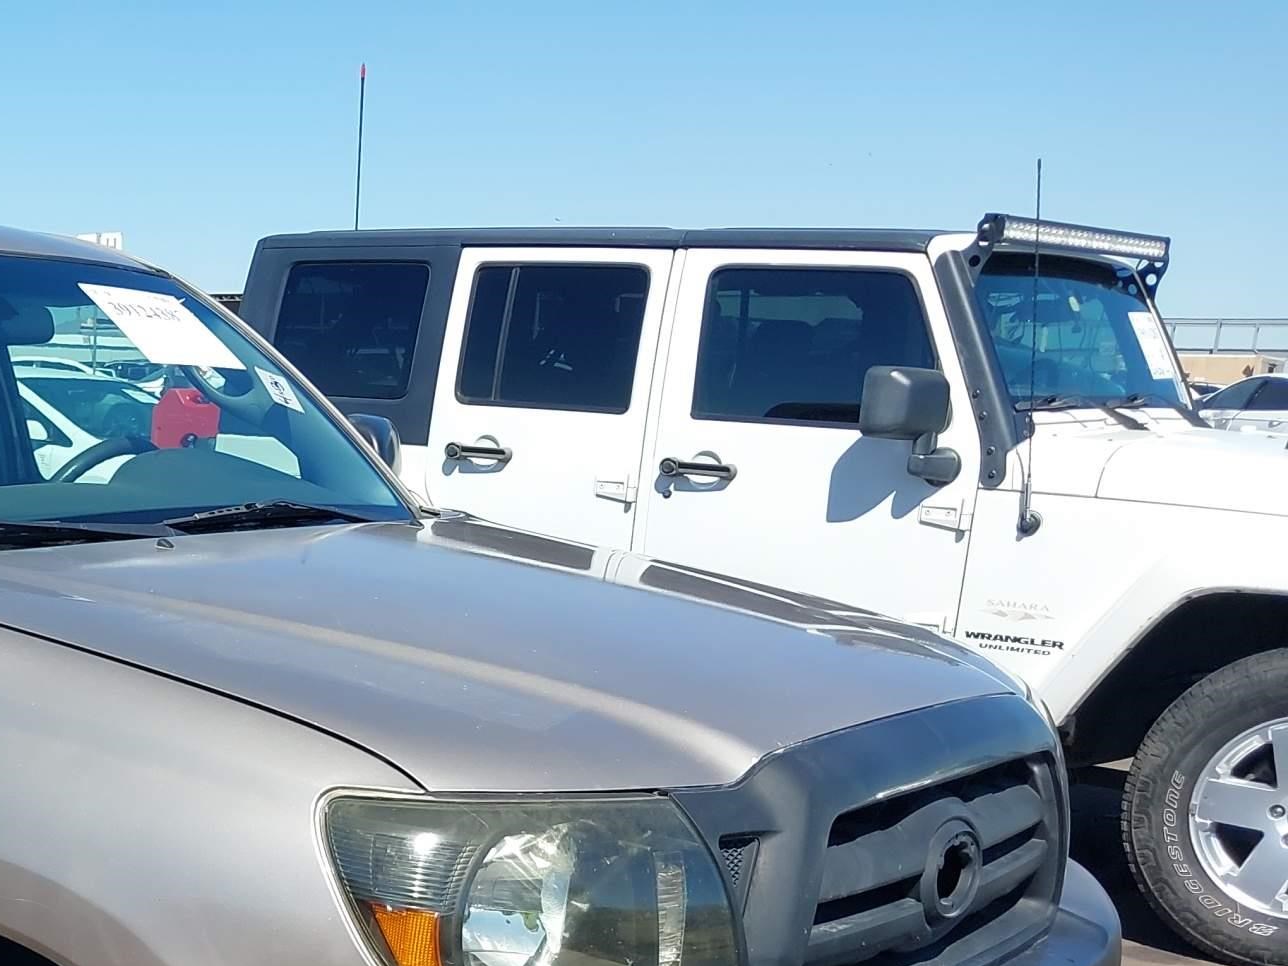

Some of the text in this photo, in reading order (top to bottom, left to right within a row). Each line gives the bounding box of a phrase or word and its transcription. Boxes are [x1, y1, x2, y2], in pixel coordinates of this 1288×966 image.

[986, 599, 1050, 612] SAHARA
[964, 630, 1065, 651] WRANGLER
[978, 642, 1052, 656] UNLIMITED
[1160, 769, 1280, 937] BRIDGESTONE
